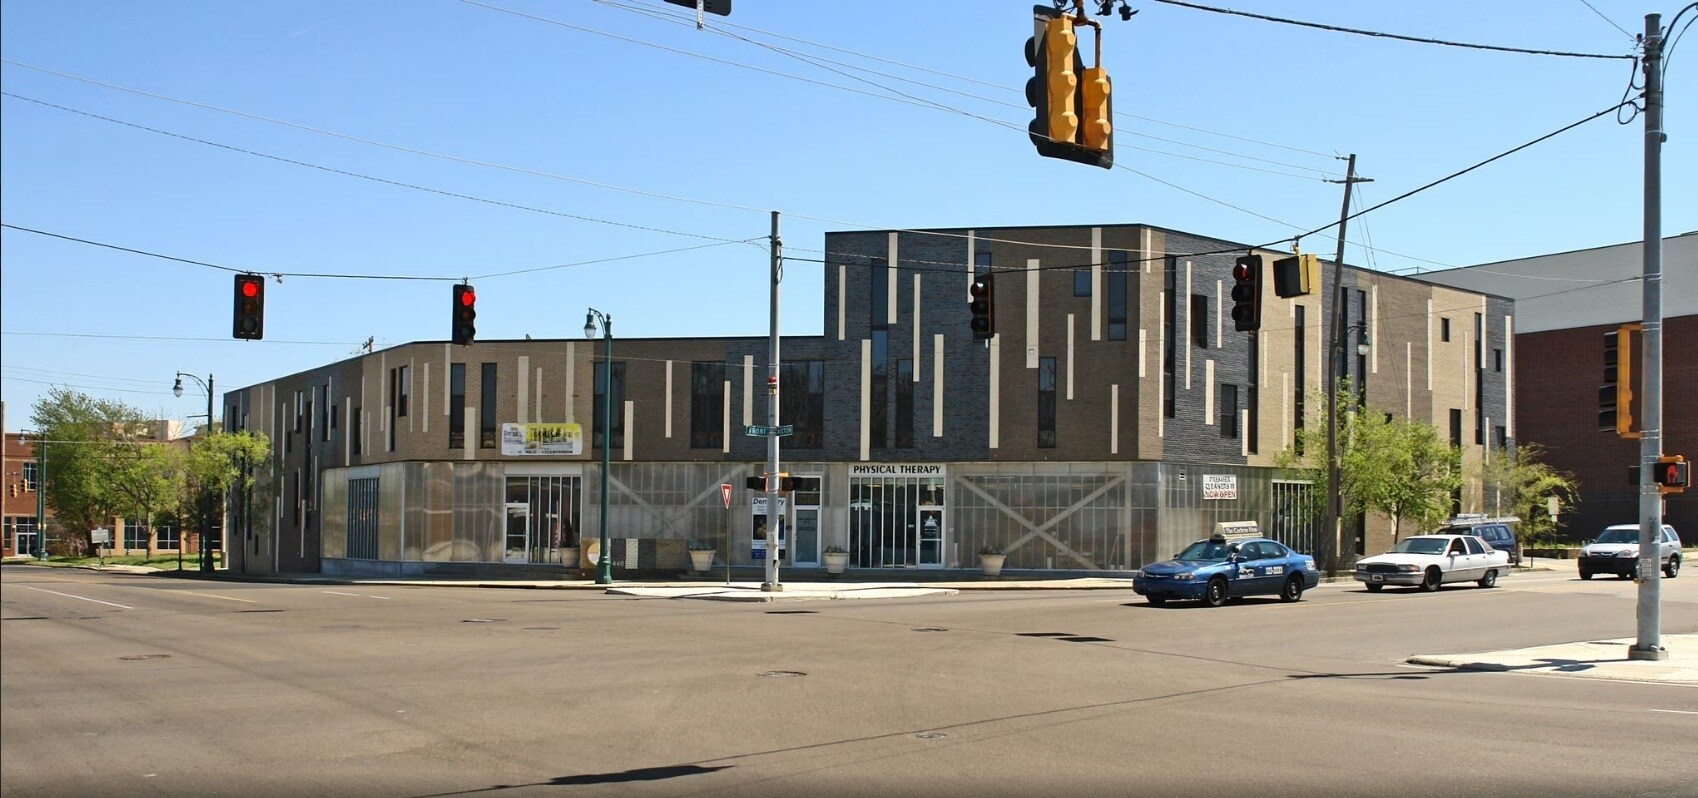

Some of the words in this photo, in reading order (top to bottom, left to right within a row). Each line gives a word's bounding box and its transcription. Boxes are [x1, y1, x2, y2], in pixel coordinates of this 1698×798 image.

[853, 465, 897, 474] PHYSICAL
[900, 465, 941, 474] THERAPY
[753, 498, 785, 506] Denry
